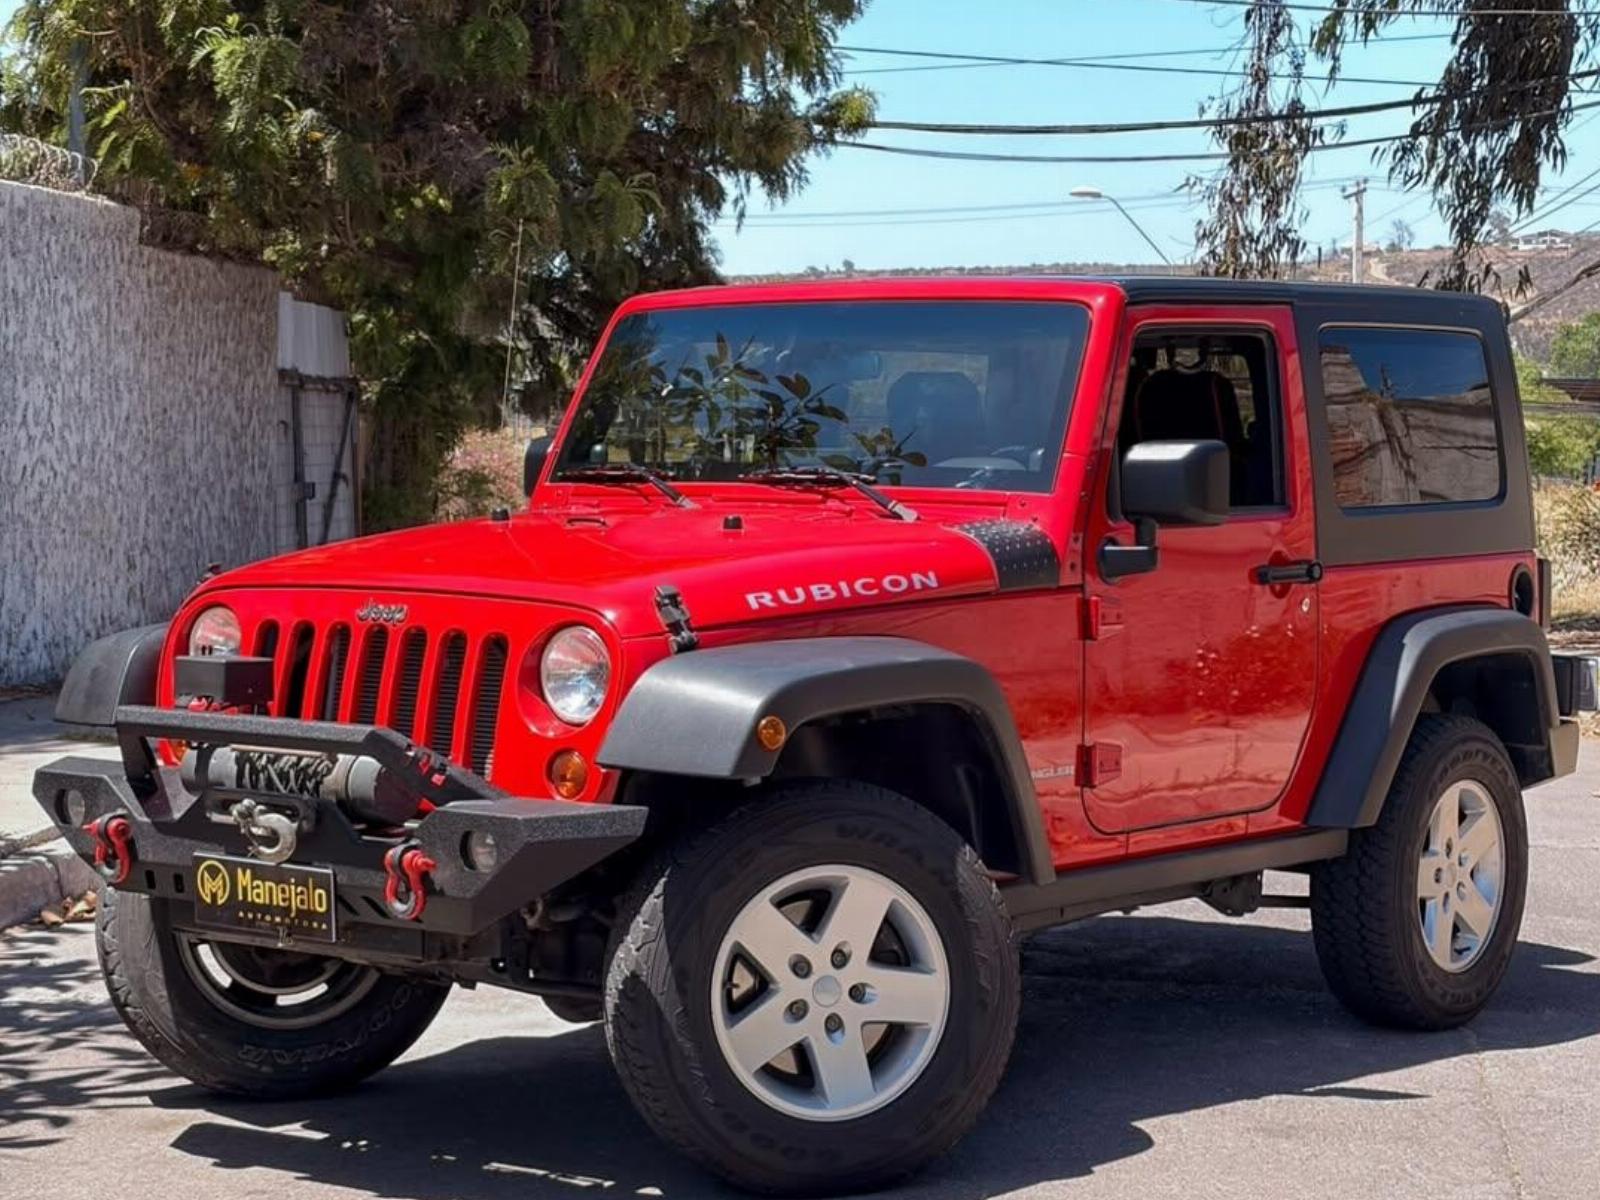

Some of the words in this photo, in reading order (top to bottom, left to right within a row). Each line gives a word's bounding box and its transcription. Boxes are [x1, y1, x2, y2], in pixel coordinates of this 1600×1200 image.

[745, 571, 939, 610] RUBICON
[355, 597, 408, 624] Jeep
[237, 867, 327, 917] Manejalo
